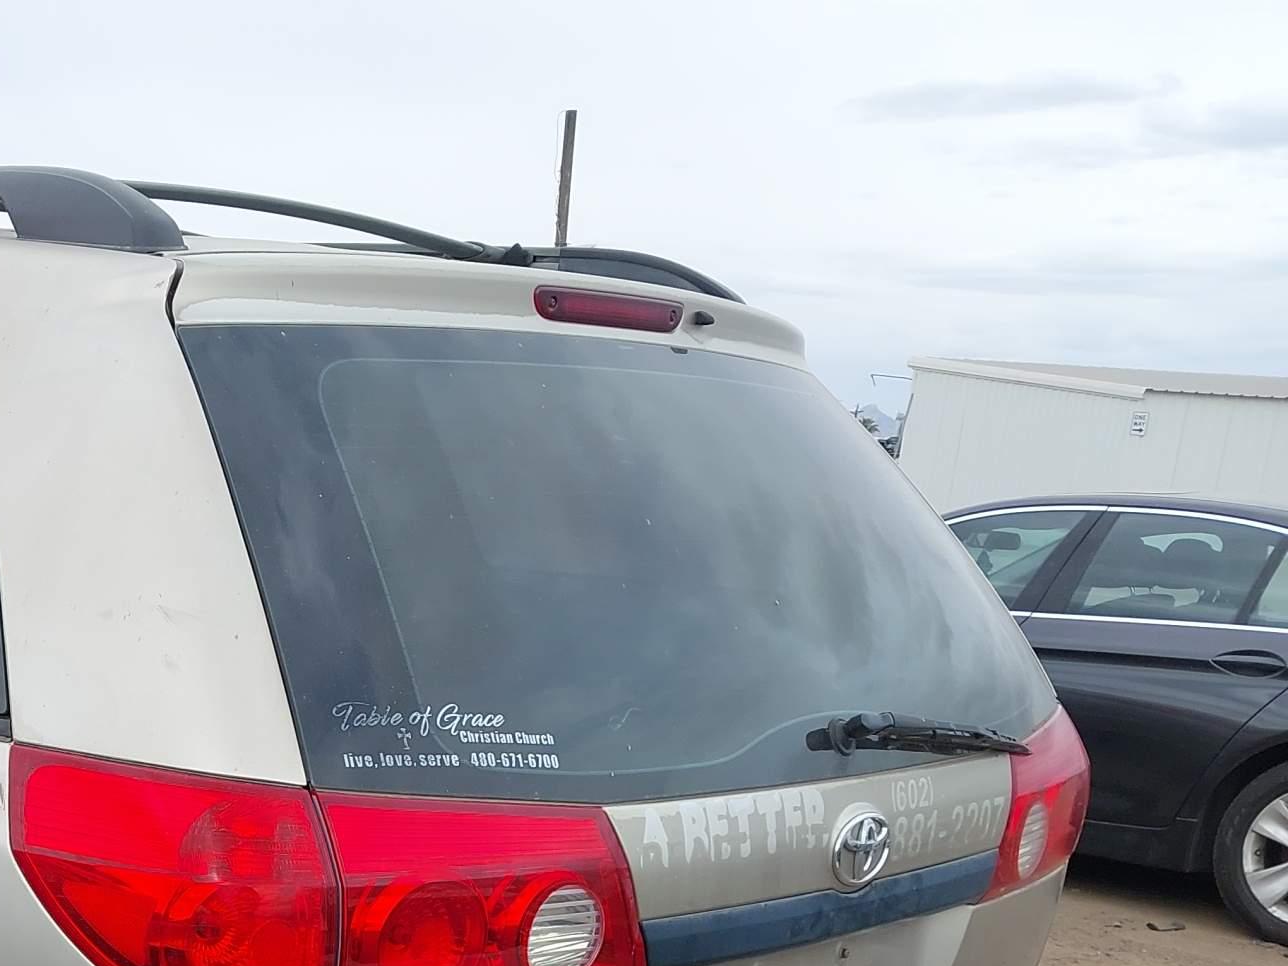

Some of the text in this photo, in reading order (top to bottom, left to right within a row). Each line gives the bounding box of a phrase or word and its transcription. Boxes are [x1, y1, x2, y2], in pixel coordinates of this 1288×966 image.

[332, 701, 505, 737] Table of Grace
[459, 731, 554, 745] Christian Church
[470, 752, 559, 769] 480-671-6700
[892, 776, 934, 812] (602)
